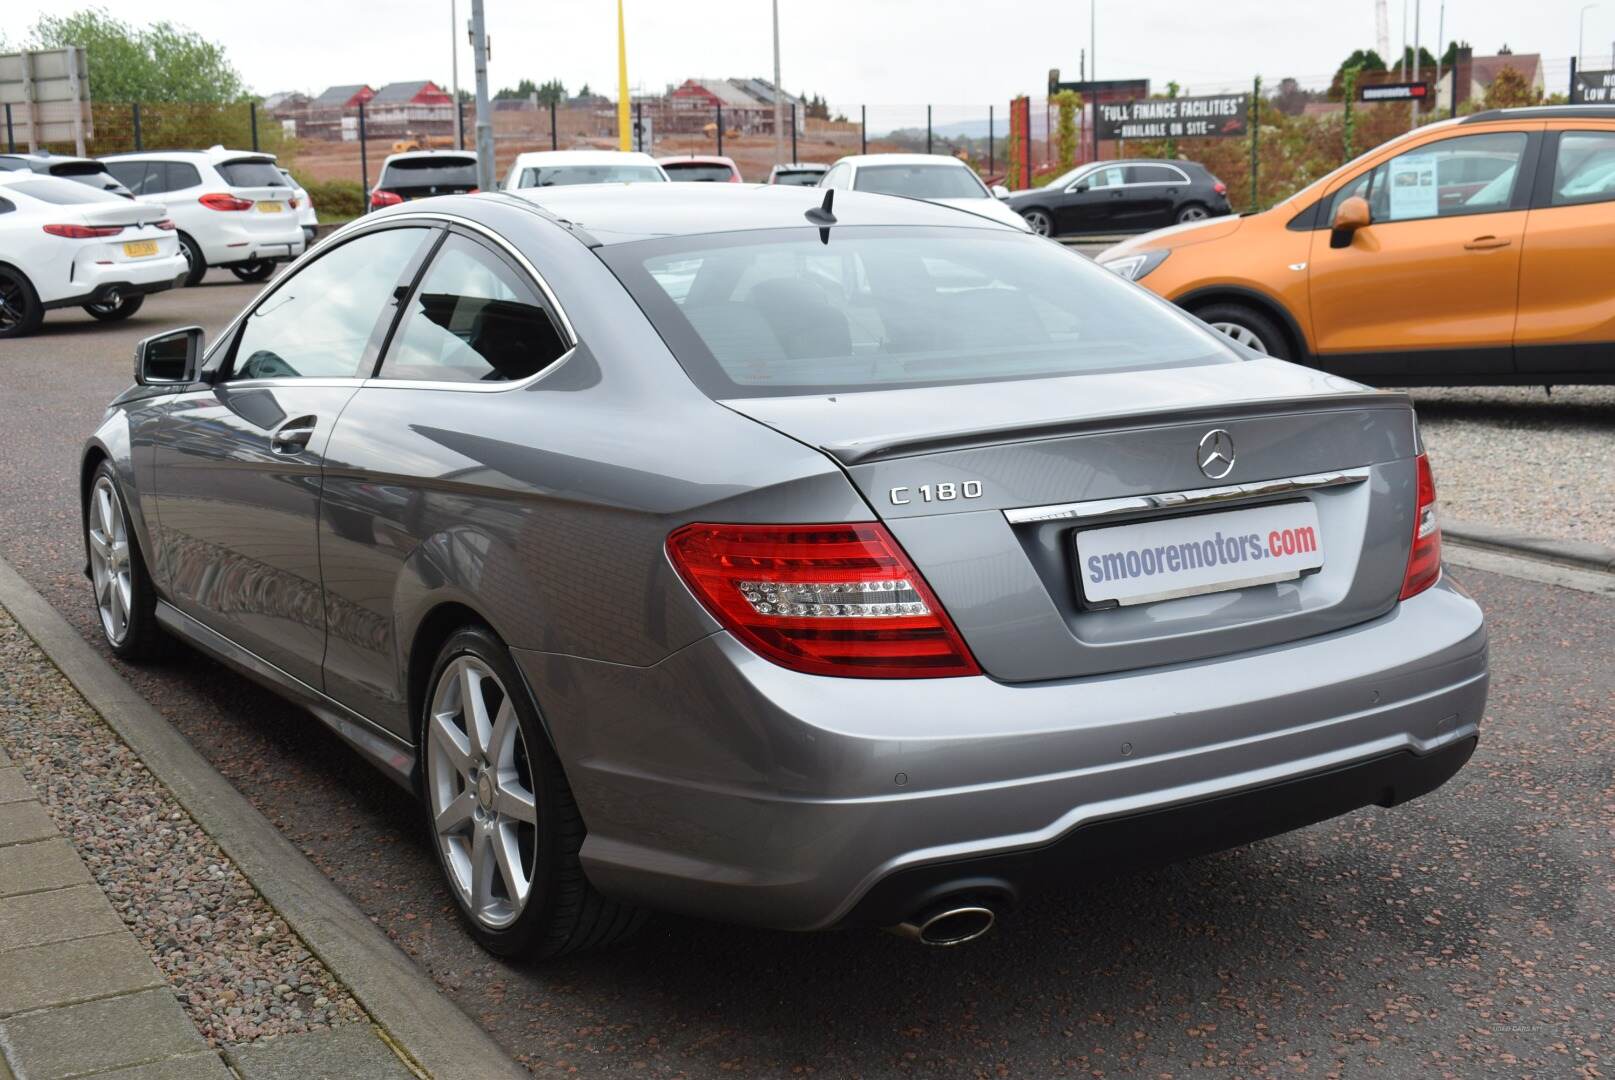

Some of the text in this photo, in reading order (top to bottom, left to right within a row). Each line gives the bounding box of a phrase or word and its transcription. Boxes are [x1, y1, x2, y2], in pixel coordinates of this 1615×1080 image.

[1133, 102, 1177, 121] FINANCE
[1170, 123, 1183, 136] ON
[890, 480, 983, 505] C 180
[1087, 525, 1317, 583] smooremotors.com
